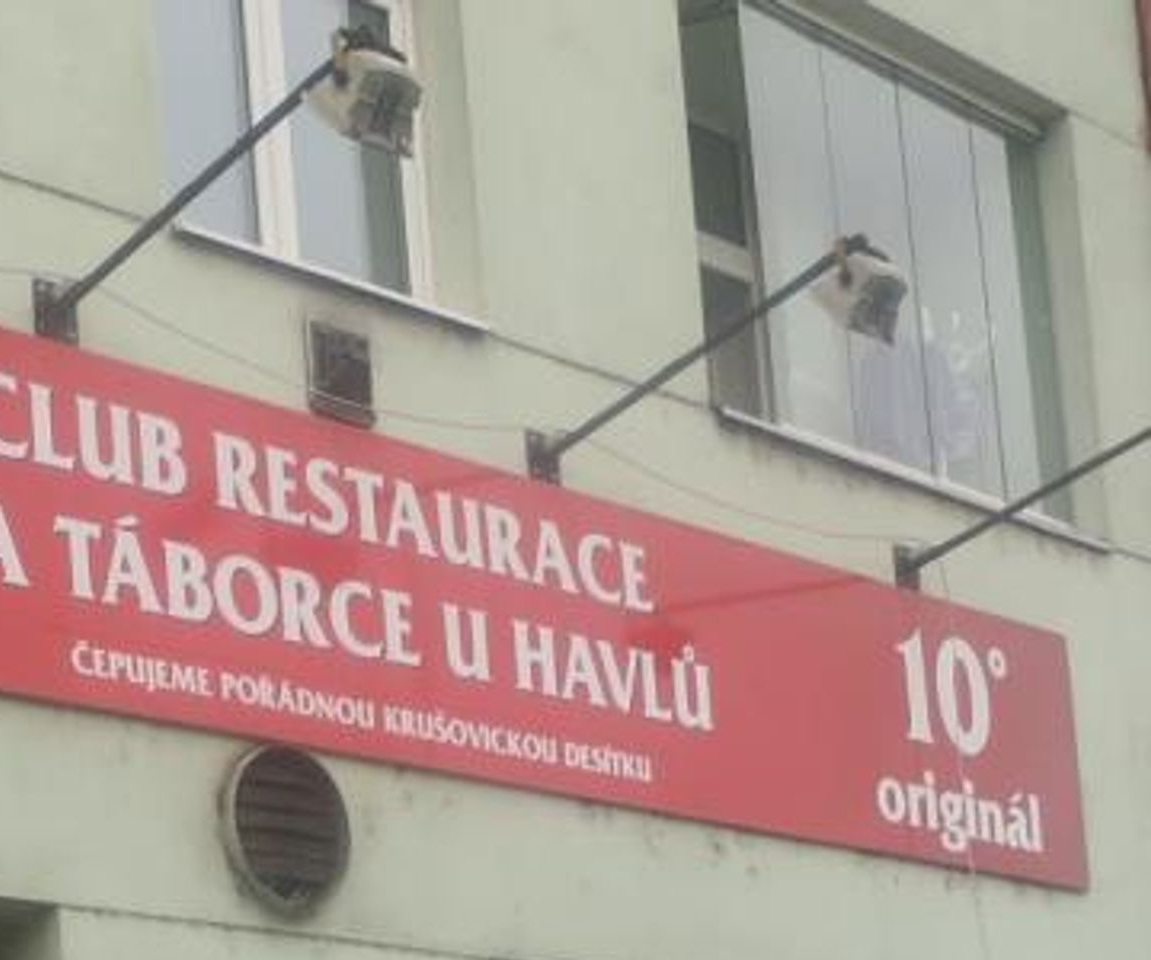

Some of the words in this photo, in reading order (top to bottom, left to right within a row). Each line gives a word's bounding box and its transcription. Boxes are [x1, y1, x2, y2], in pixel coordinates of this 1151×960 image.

[213, 432, 654, 614] RESTAURACE
[54, 514, 421, 668] TÁBORCE
[442, 602, 490, 681] U
[512, 618, 714, 731] HAVLŮ
[71, 640, 213, 697] ČEPUJEME
[383, 702, 558, 764] KRUŠOVICKOU
[564, 741, 652, 782] DESÍTKU
[877, 770, 1043, 852] originál
